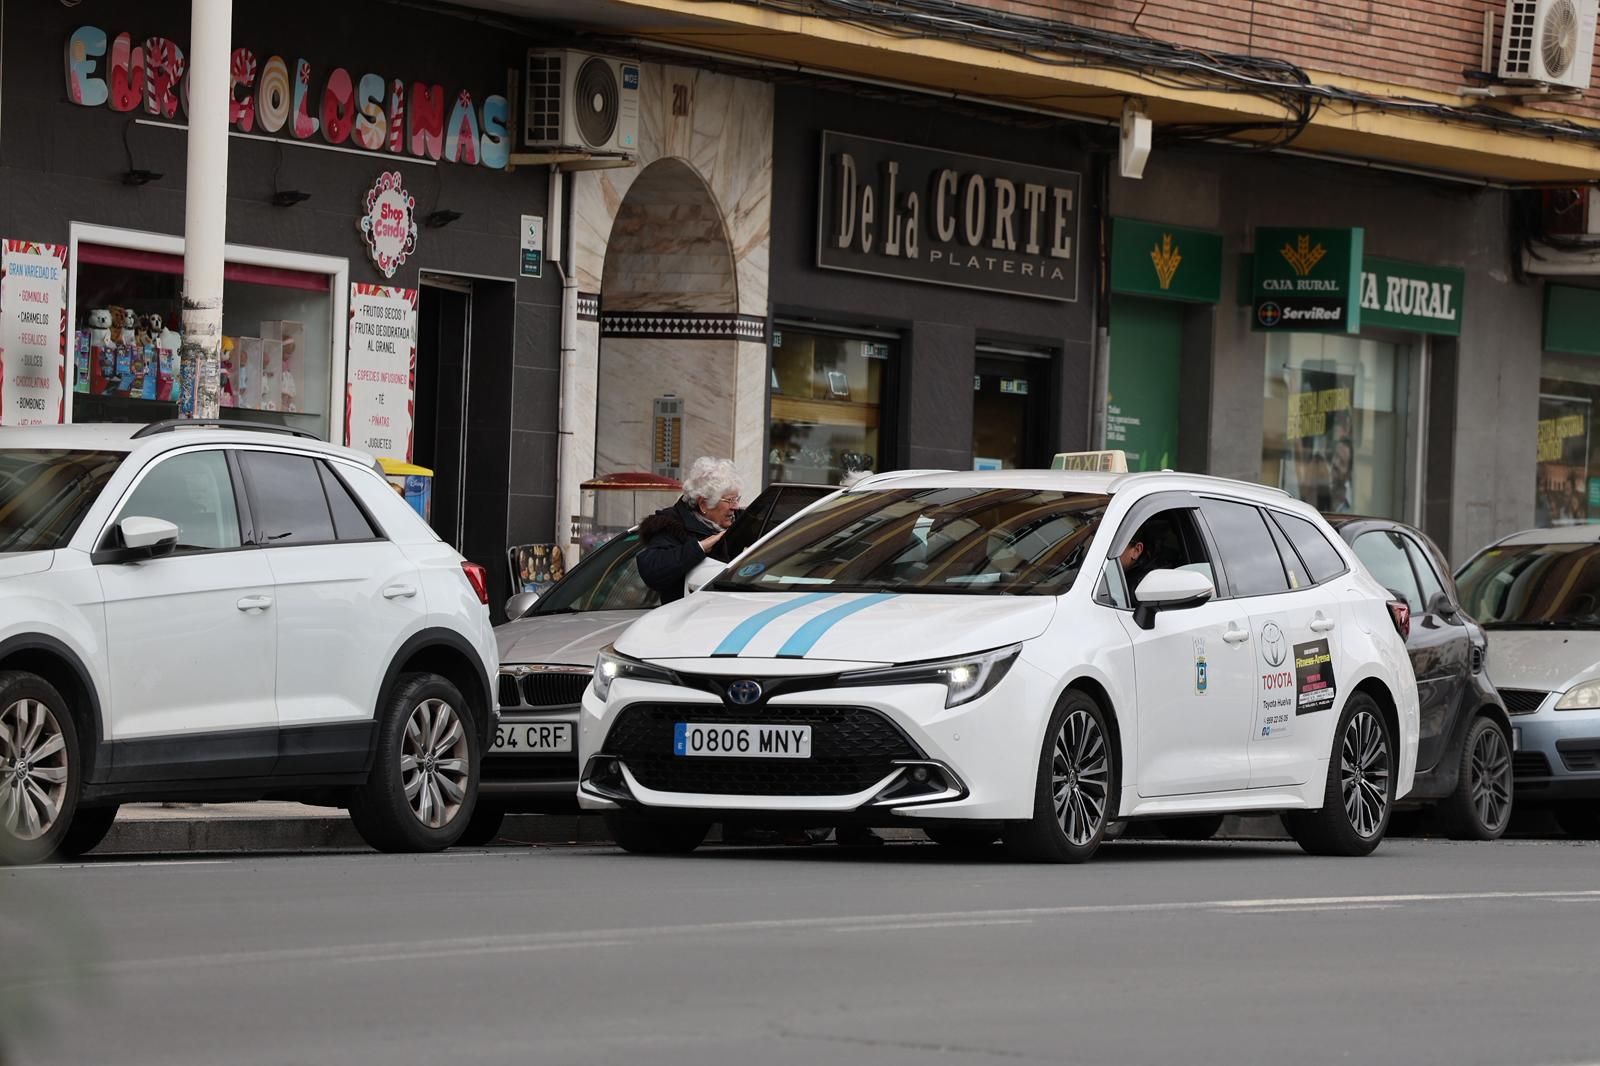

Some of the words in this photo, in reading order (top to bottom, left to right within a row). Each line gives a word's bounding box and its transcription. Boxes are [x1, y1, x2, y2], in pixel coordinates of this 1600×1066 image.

[66, 25, 509, 168] EURGOLOSINAS
[380, 203, 404, 224] Shop
[838, 152, 874, 254] De
[885, 161, 919, 259] La
[936, 168, 1073, 260] CORTE
[374, 220, 406, 242] Candy
[8, 262, 24, 276] GRAN
[24, 264, 49, 279] VARIEDAD
[930, 249, 1064, 280] PLATERÍA
[1296, 280, 1340, 291] RURAL
[22, 290, 49, 304] GOMINOLAS
[1384, 276, 1456, 320] RURAL
[21, 311, 49, 325] CARAMELOS
[363, 304, 383, 319] FRUTOS
[384, 307, 402, 320] SECOS
[403, 310, 406, 320] Y
[1282, 306, 1341, 320] ServiRed
[355, 322, 375, 336] FRUTAS
[376, 324, 410, 339] DESIDRATADA
[367, 340, 374, 352] AL
[376, 340, 396, 354] GRANEL
[24, 354, 43, 367] DULCES
[16, 376, 50, 389] CHOCOLATINAS
[357, 370, 379, 382] ESPECIES
[380, 372, 407, 384] INFUSIONES
[19, 397, 45, 410] BOMBONES
[379, 392, 384, 405] TÉ
[372, 414, 390, 427] PIÑATAS
[368, 438, 392, 450] JUGUETES
[1066, 455, 1097, 471] TAXI
[1262, 672, 1292, 690] TOYOTA
[1263, 700, 1277, 710] Toyota
[1277, 697, 1291, 707] Huelva
[526, 727, 564, 748] CRF
[692, 729, 750, 752] 0806
[759, 730, 804, 753] MNY
